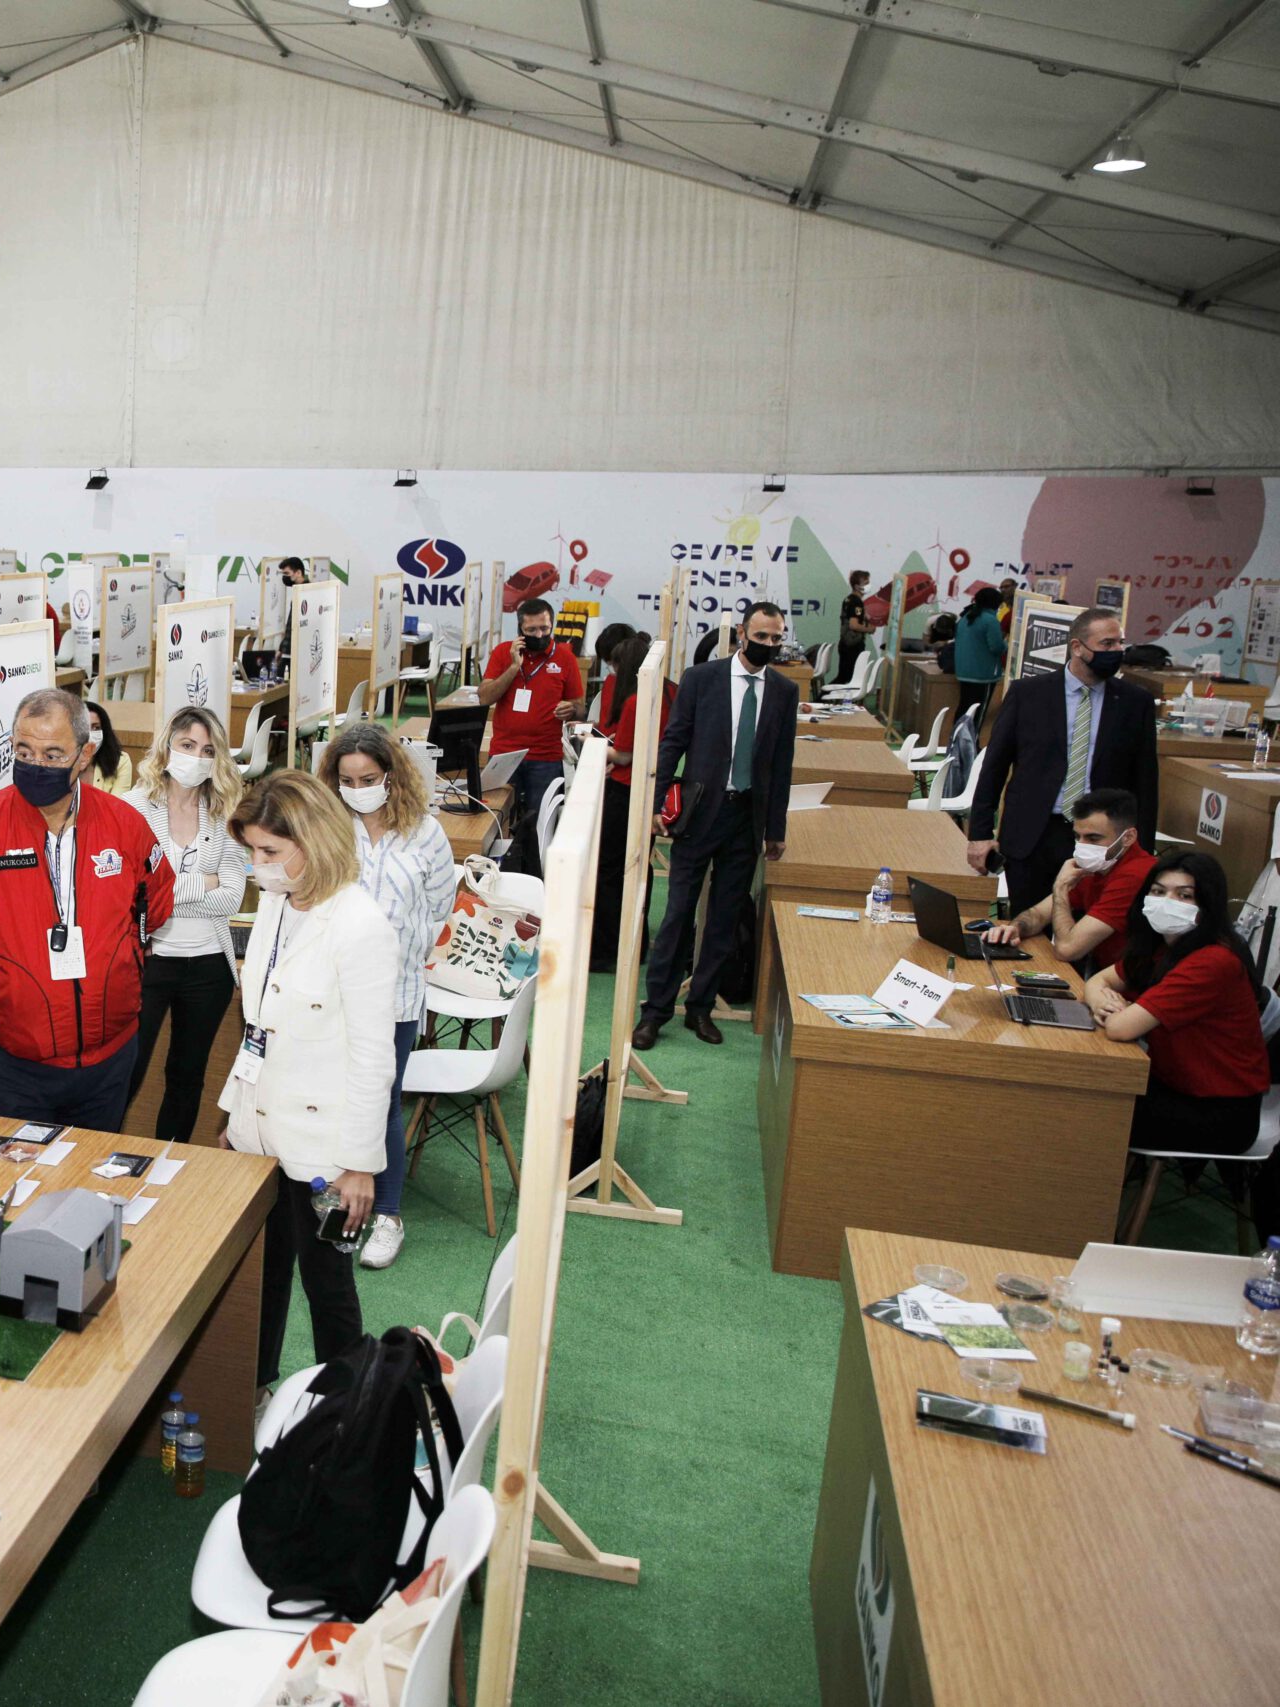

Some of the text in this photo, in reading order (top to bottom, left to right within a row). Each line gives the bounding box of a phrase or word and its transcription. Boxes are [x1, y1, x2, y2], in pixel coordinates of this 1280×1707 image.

[670, 543, 799, 564] ÇEVRE VE
[403, 583, 482, 607] ANK
[1144, 614, 1234, 639] 2.462
[7, 665, 26, 678] SANKO
[1199, 821, 1221, 841] SANKO
[893, 971, 942, 1002] Smart-Team
